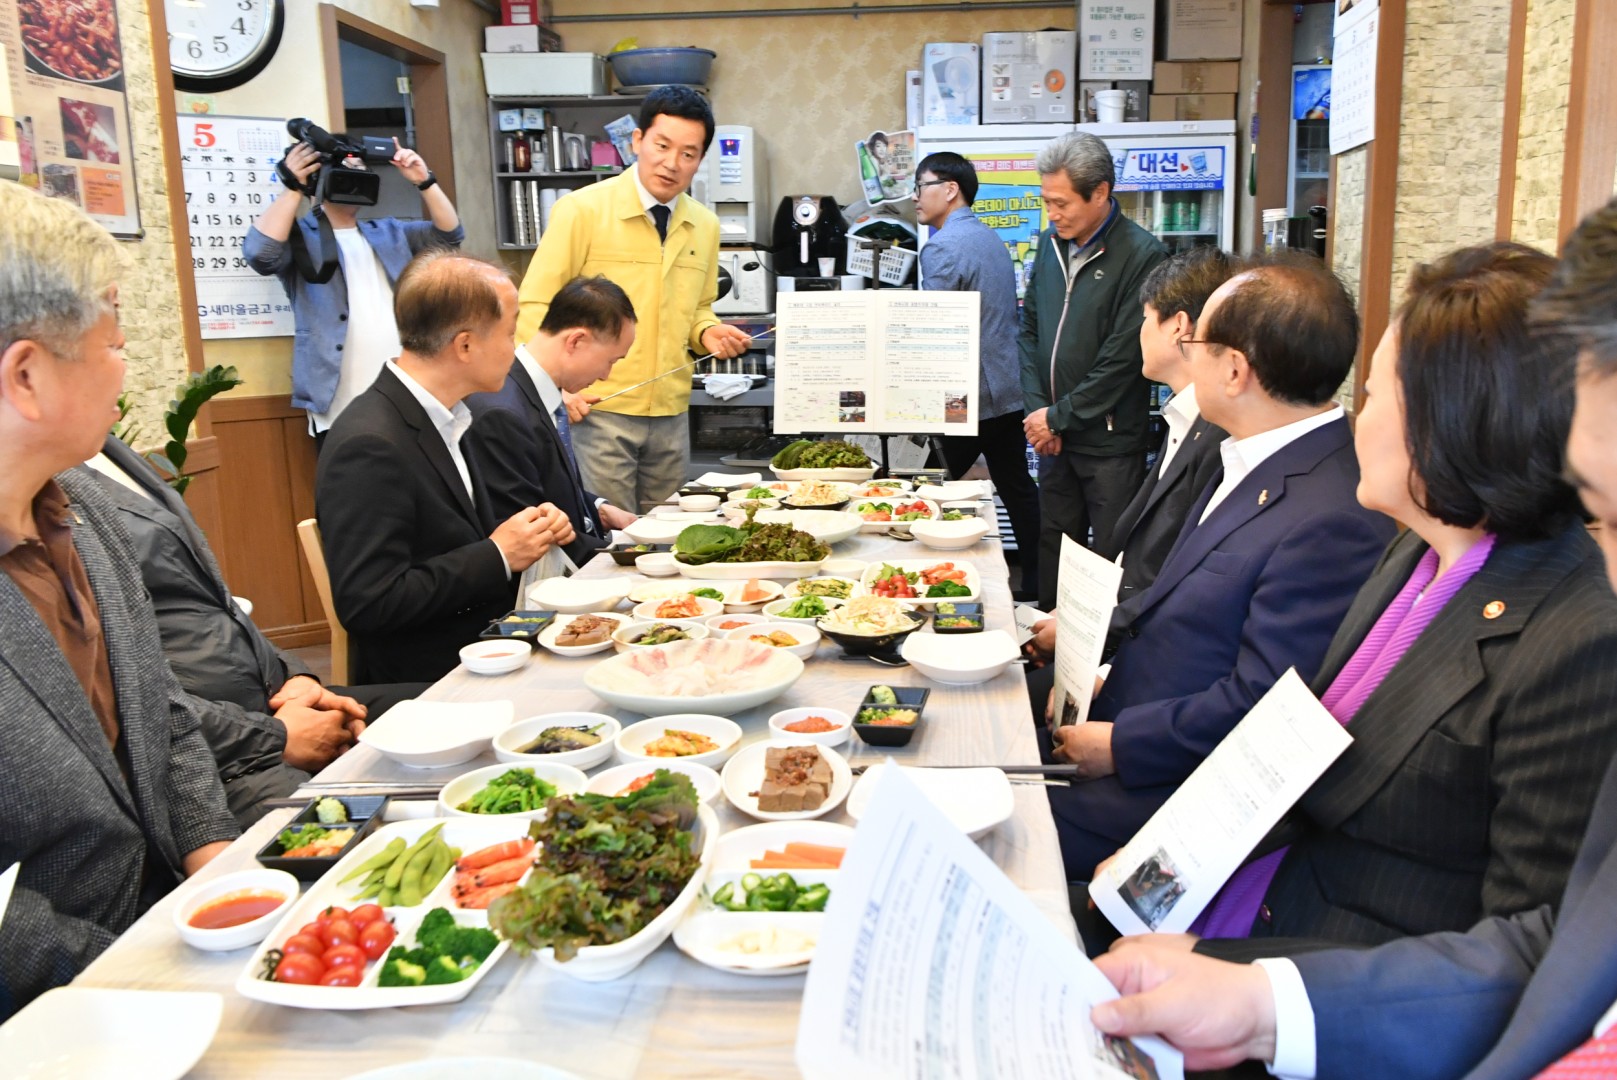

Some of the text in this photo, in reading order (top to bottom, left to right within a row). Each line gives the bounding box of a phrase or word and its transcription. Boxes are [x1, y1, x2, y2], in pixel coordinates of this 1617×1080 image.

[230, 17, 246, 35] 4
[188, 40, 202, 58] 6
[213, 36, 228, 53] 5
[193, 123, 216, 148] 5
[997, 160, 1011, 170] BIG
[1138, 152, 1178, 173] 대선
[206, 171, 277, 183] 1 2 3 4
[185, 192, 192, 203] 7
[207, 193, 216, 204] 8
[228, 193, 237, 204] 9
[247, 193, 260, 204] 10
[971, 196, 1042, 213] 은데이 마시고
[191, 214, 199, 225] 4
[206, 214, 221, 226] 15
[228, 214, 242, 226] 16
[190, 236, 246, 247] 21 22 23
[192, 258, 248, 268] 28 29 30
[210, 304, 272, 316] 새마을금고
